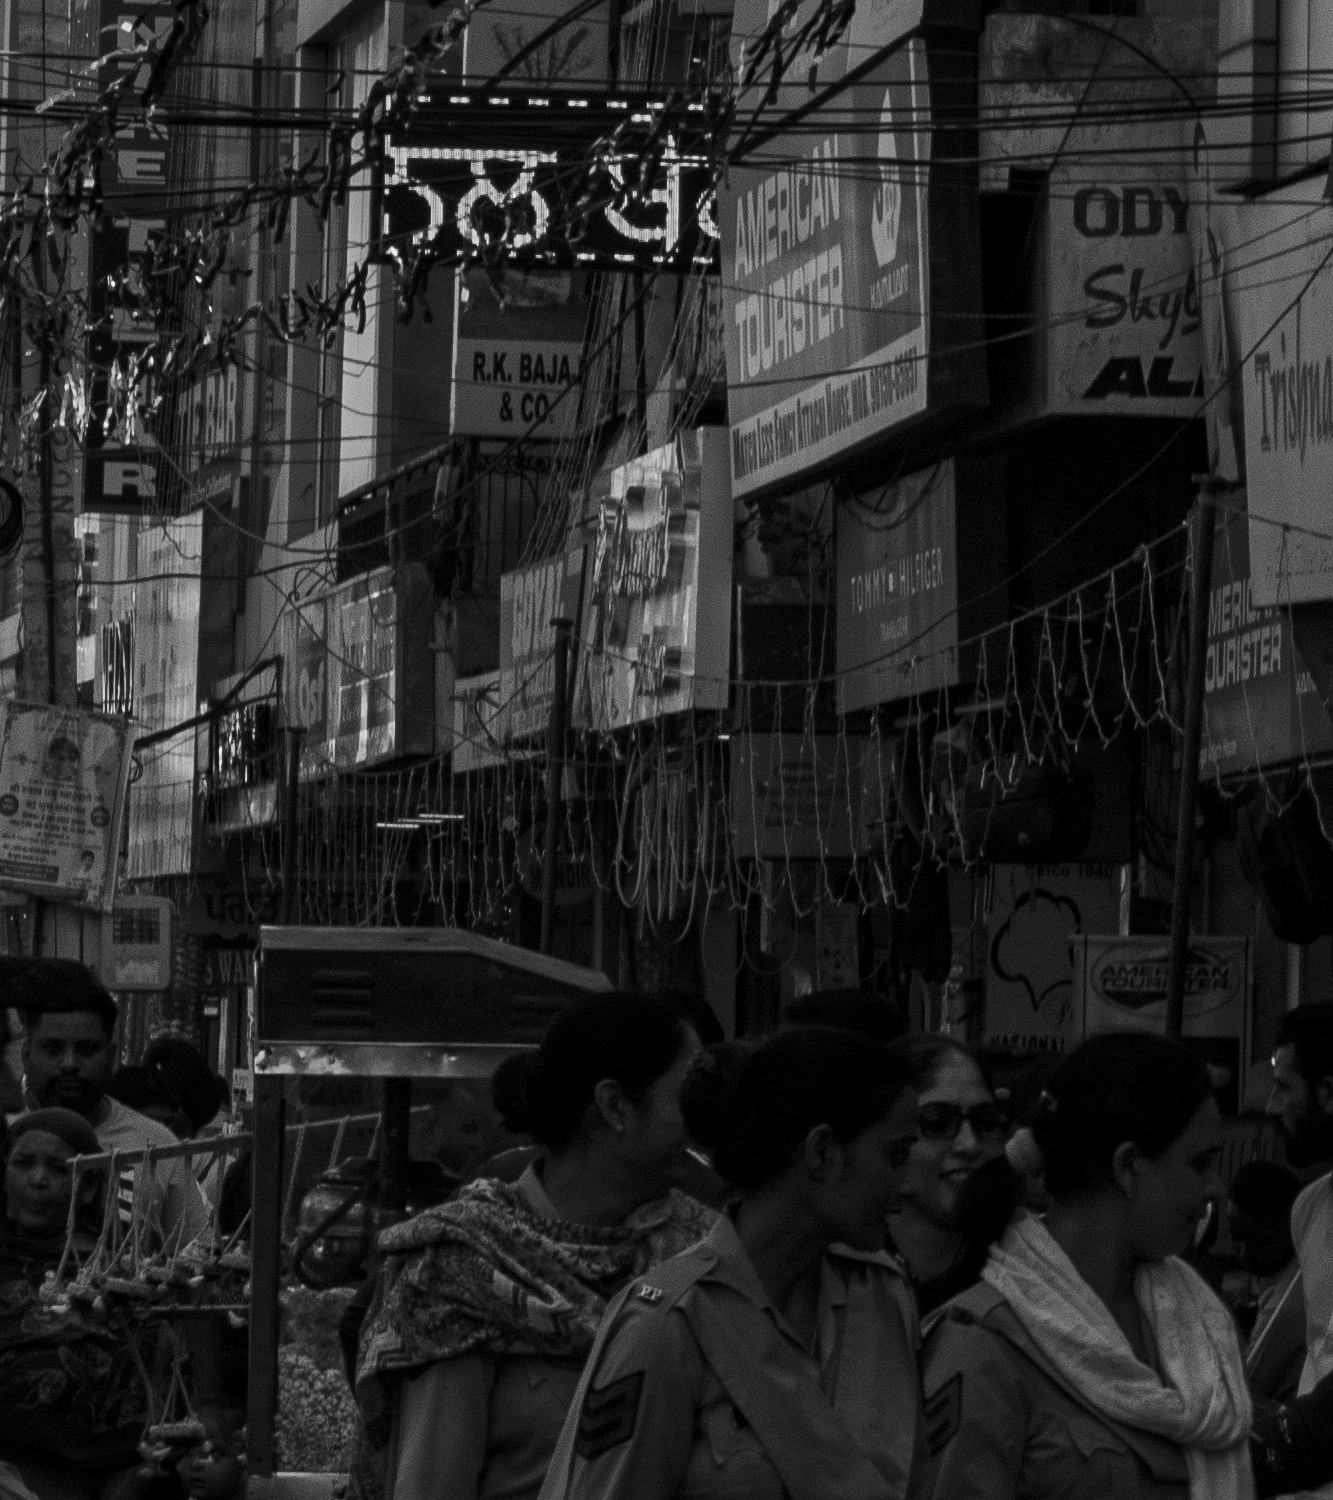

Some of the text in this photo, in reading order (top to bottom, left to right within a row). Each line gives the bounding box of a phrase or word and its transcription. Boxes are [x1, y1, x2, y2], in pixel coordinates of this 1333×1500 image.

[735, 133, 840, 282] AMERICAN
[735, 243, 844, 384] TOURISTER
[473, 351, 513, 383] R.K.
[1082, 355, 1204, 399] AL
[499, 391, 513, 423] &
[850, 545, 944, 614] TOMMY HILFIGER
[1204, 621, 1283, 695] OURISTER
[1099, 965, 1229, 979] AMERCAN
[1101, 978, 1229, 991] TOURITER
